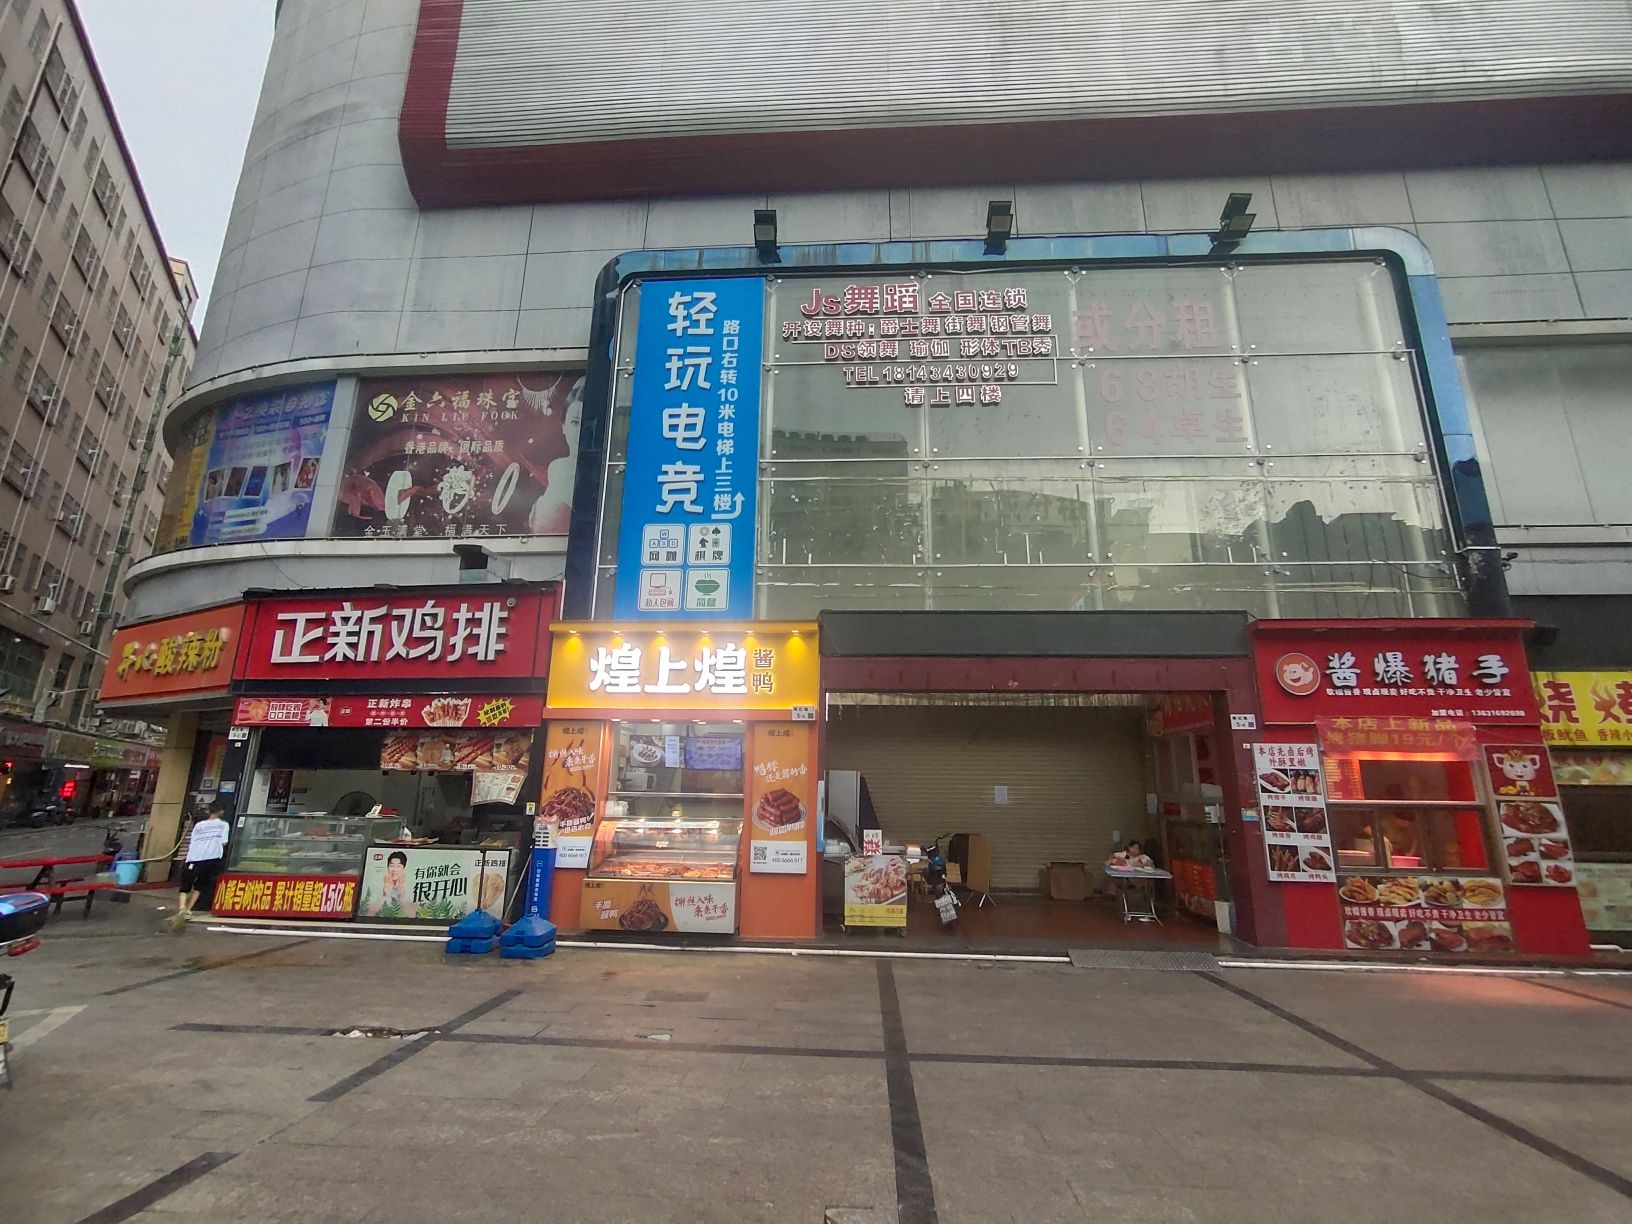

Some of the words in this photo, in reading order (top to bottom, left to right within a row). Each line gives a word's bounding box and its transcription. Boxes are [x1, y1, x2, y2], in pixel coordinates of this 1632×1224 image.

[801, 283, 920, 315] Js舞蹈
[929, 288, 1028, 312] 全国连锁
[825, 340, 899, 359] DS领舞
[910, 340, 950, 358] 瑜伽
[843, 366, 879, 383] TEL
[883, 362, 1019, 382] 18143430929
[402, 389, 521, 411] 金六福珠宝
[656, 291, 717, 514] 轻玩电竞
[905, 385, 1002, 405] 请上四楼
[402, 413, 430, 423] KIN
[713, 319, 740, 512] 路口右转10米电梯上三楼
[404, 441, 449, 454] 香港品牌
[459, 440, 505, 453] 国际品质
[695, 551, 724, 561] 棋牌
[270, 600, 509, 664] 正新鸡排
[590, 642, 748, 694] 煌上煌
[752, 648, 775, 693] 酱鸭
[1325, 651, 1509, 688] 酱爆猪手
[365, 717, 409, 726] 第二份半价
[1331, 717, 1458, 731] 本店上新品
[1258, 746, 1315, 757] 本店先卤后烤
[1269, 757, 1307, 768] 外酥里嫩
[415, 863, 461, 880] 有你就会
[413, 877, 467, 903] 很开心
